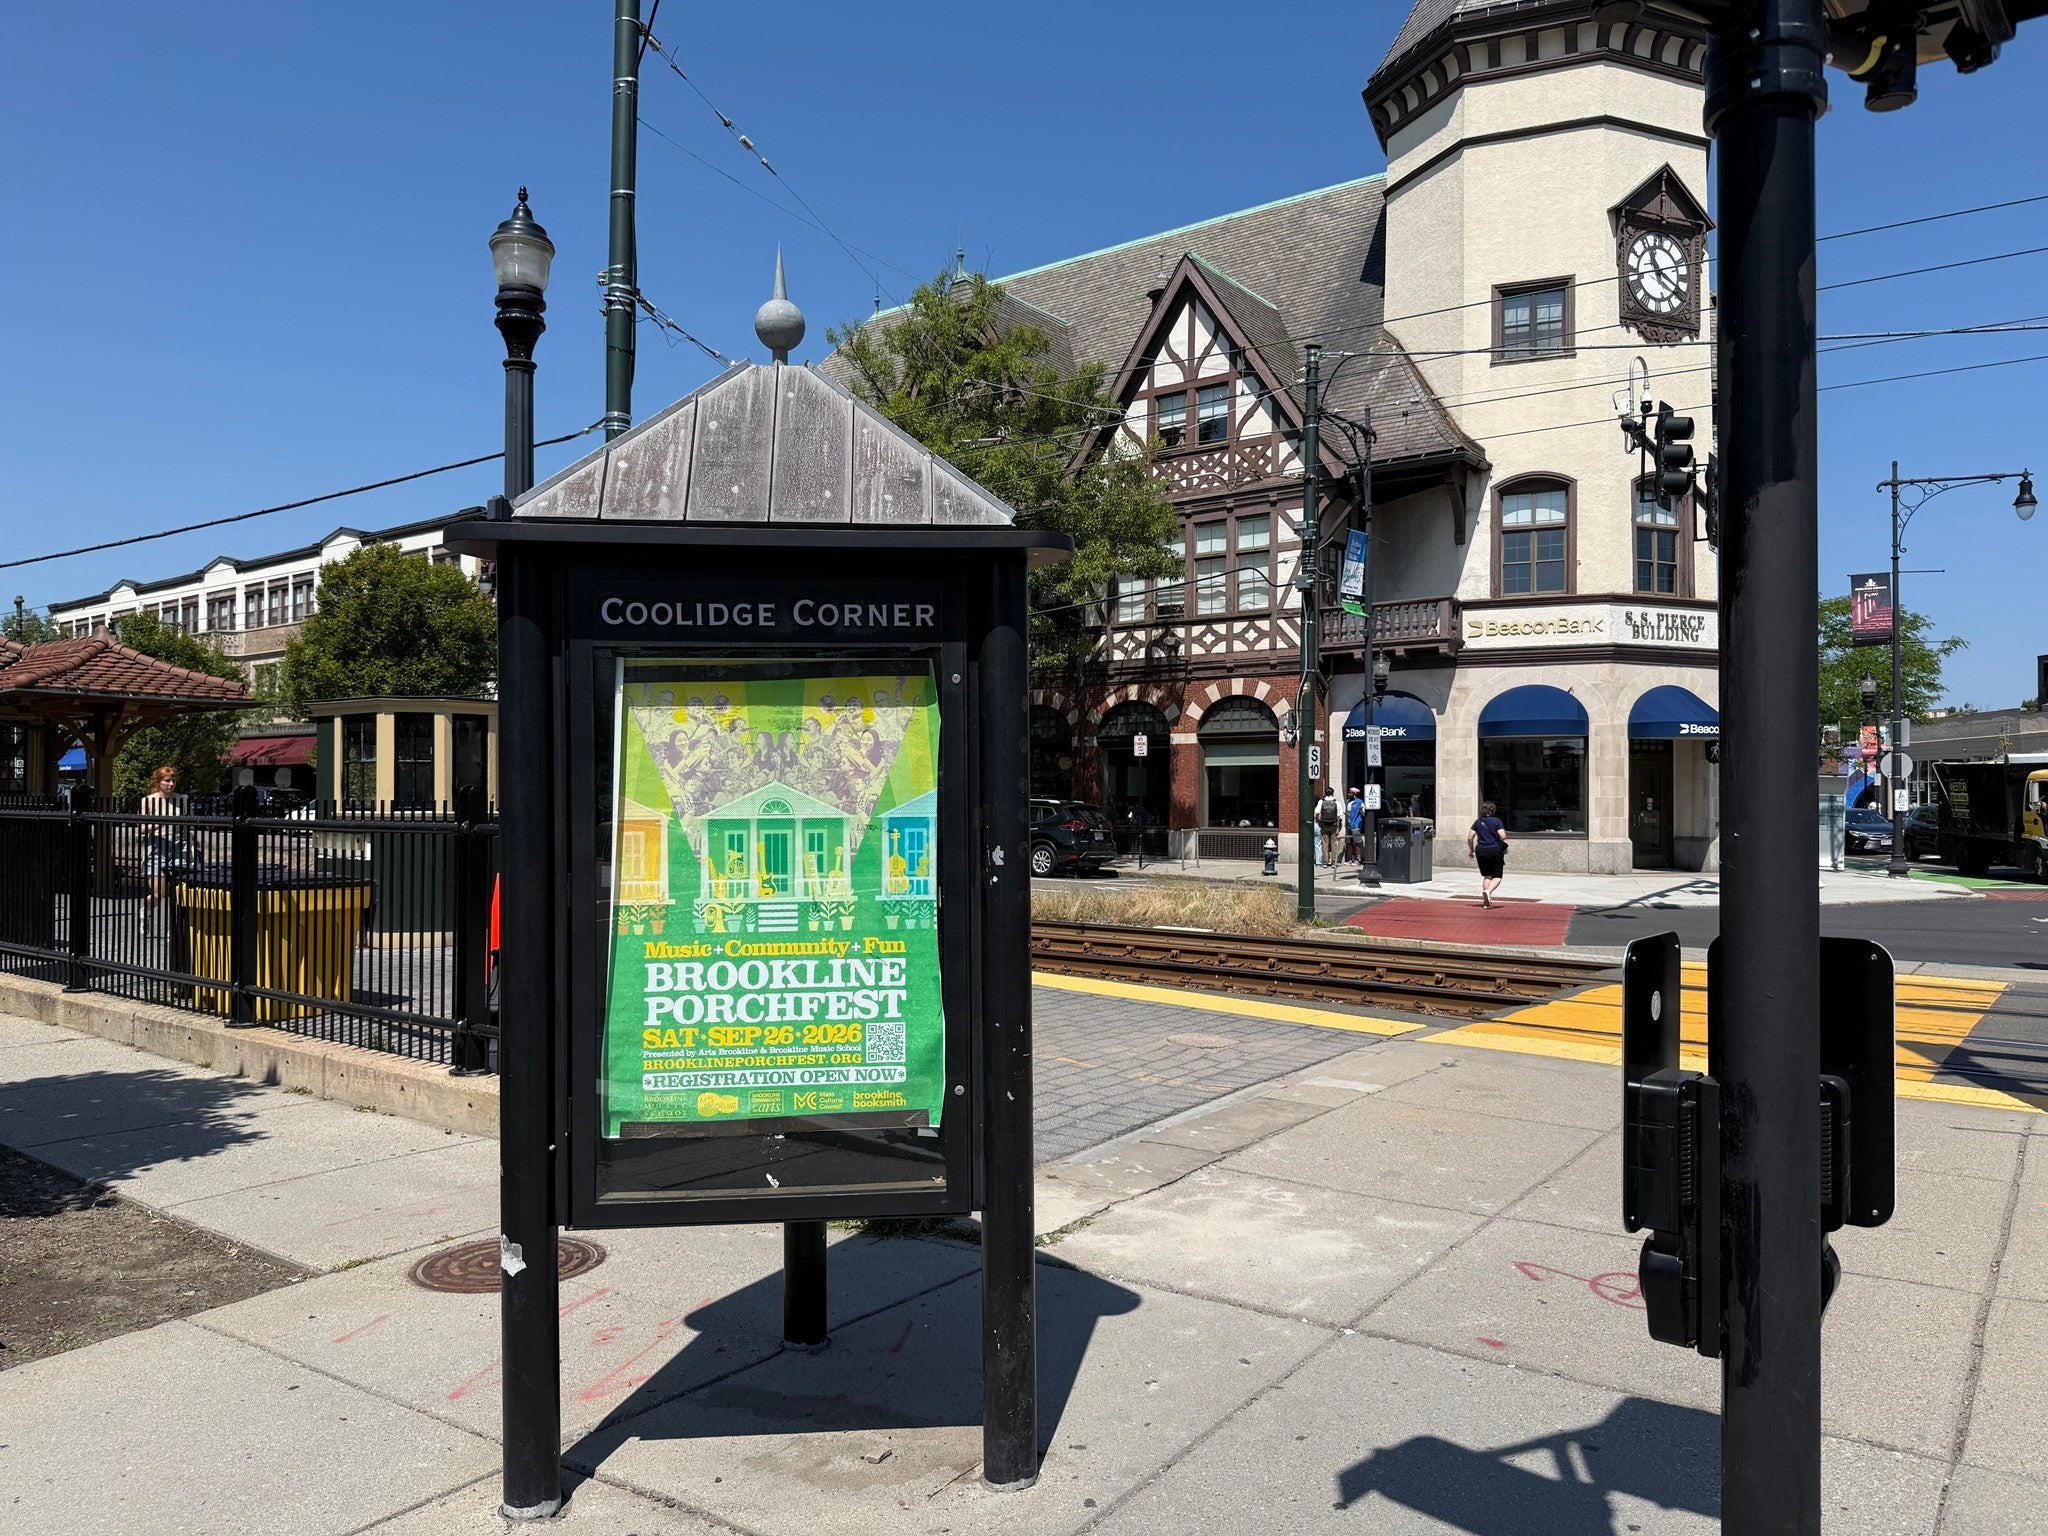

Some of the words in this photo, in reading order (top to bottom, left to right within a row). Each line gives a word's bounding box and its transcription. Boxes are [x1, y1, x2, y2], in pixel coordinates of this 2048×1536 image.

[601, 598, 776, 626] COOLIDGE
[793, 599, 935, 627] CORNER
[1656, 612, 1705, 631] PIERCE
[1486, 618, 1604, 637] BeaconBank
[1632, 624, 1699, 643] BUILDING
[1350, 727, 1407, 738] BeaBank
[1311, 749, 1319, 762] S
[1310, 764, 1319, 776] 10
[643, 940, 712, 959] Music
[724, 938, 851, 959] Community
[863, 937, 907, 954] Fun
[644, 958, 906, 992] BROOKLINE
[643, 989, 907, 1026] PORCHFEST
[643, 1049, 685, 1058] Presented
[686, 1048, 696, 1057] by
[699, 1047, 717, 1056] Arts
[719, 1046, 758, 1056] Brookline
[769, 1045, 808, 1054] Brookline
[810, 1044, 834, 1053] Music
[836, 1044, 861, 1052] School
[643, 1053, 863, 1070] BROOKLINEPORCHFEST.ORG
[652, 1071, 796, 1088] REGISTRATION
[800, 1069, 851, 1084] OPEN
[854, 1068, 897, 1081] NOW
[853, 1090, 902, 1100] brookline
[853, 1098, 907, 1108] booksmith
